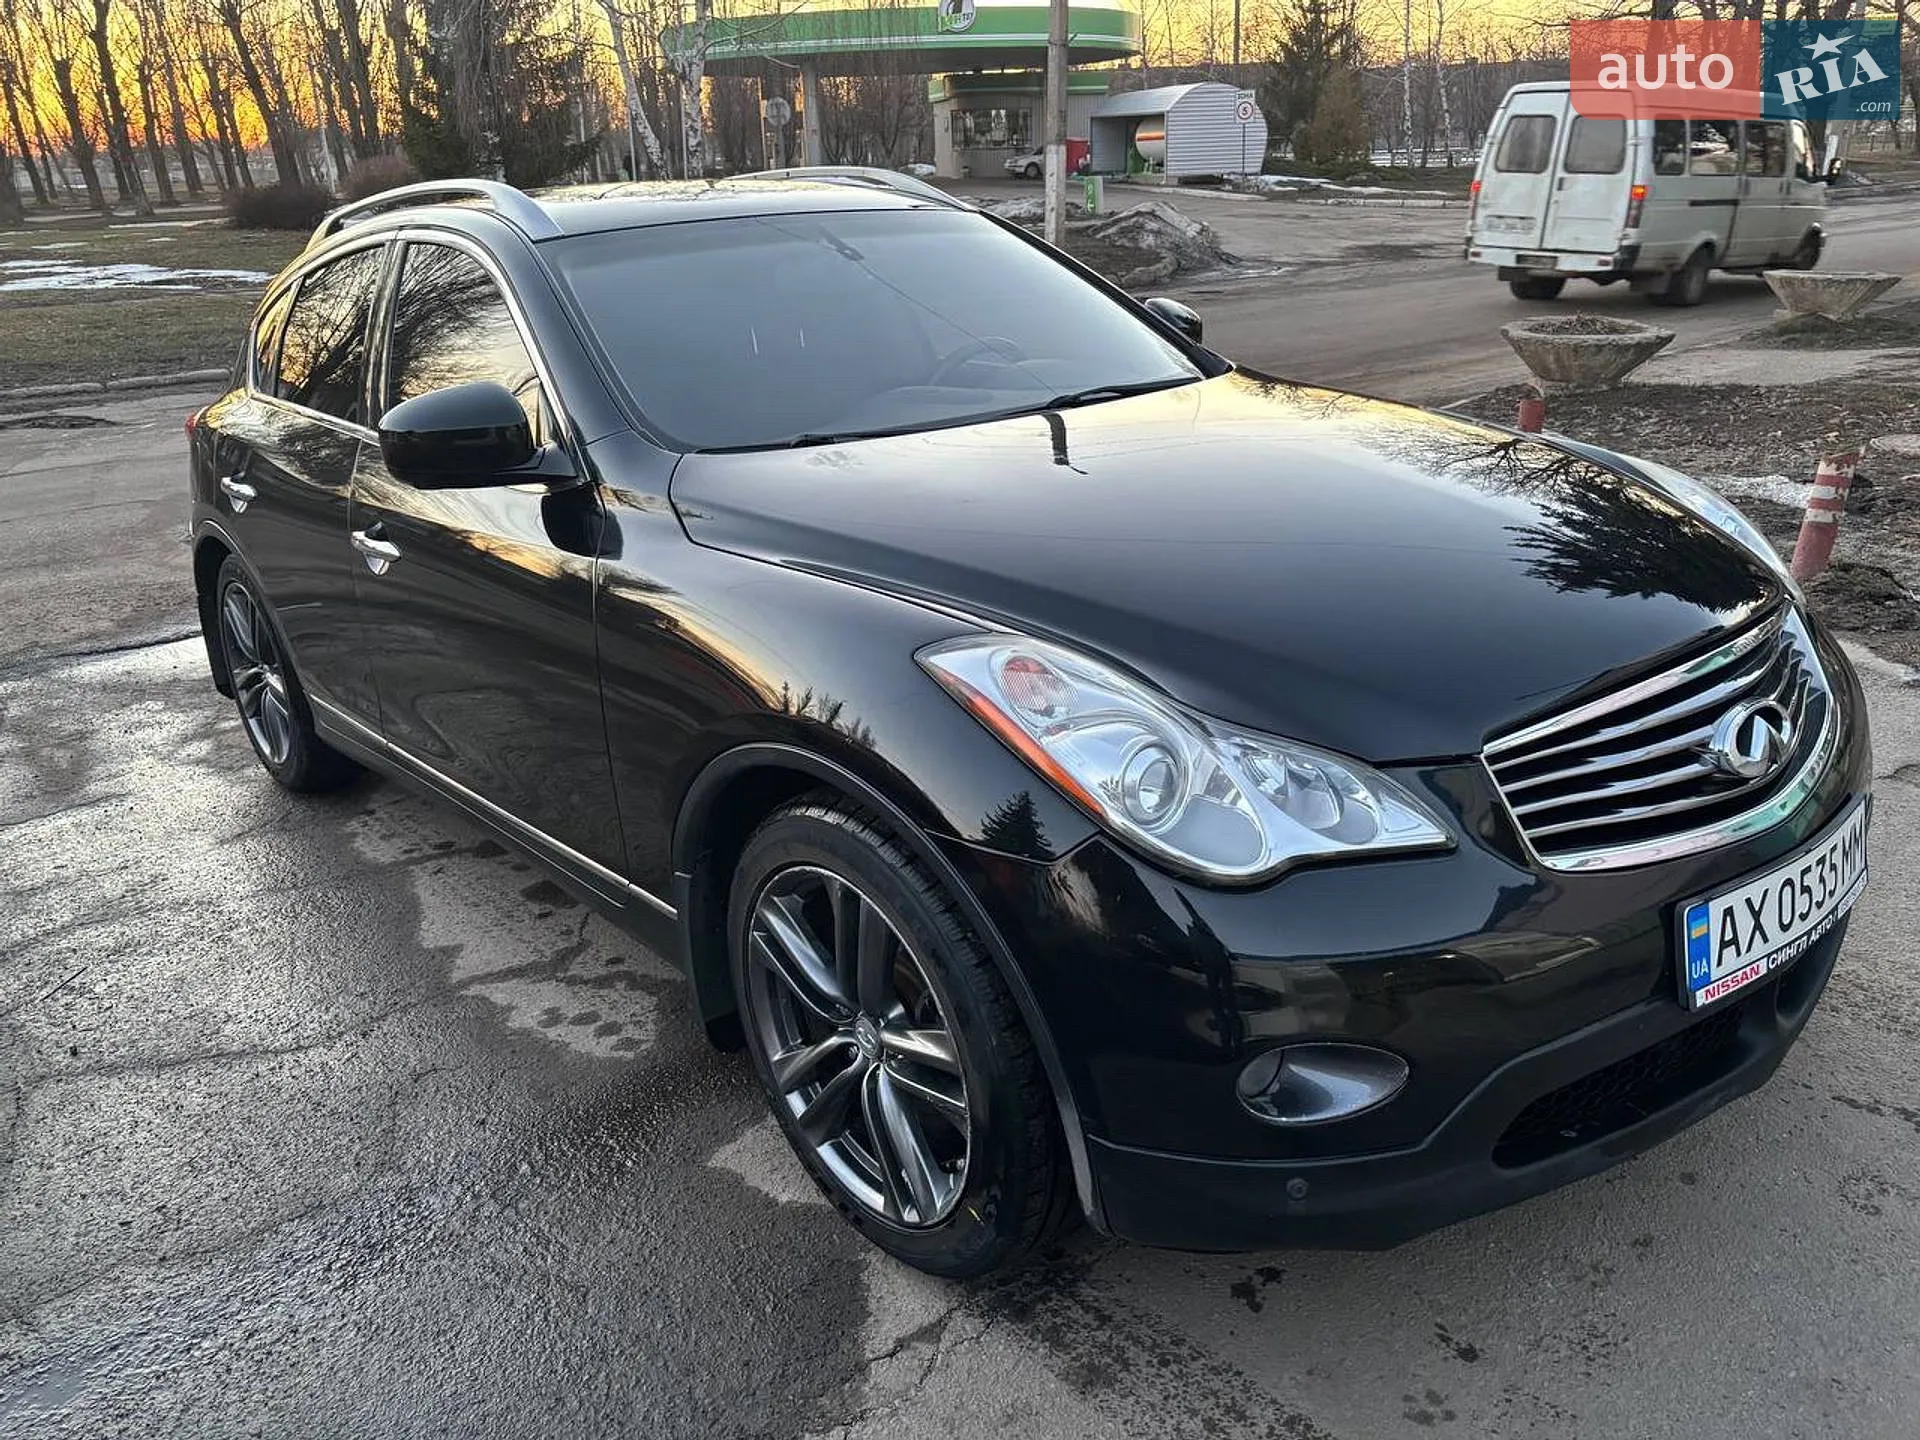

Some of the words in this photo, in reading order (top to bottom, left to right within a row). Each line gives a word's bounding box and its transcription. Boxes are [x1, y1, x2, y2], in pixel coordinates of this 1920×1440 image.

[1715, 887, 1770, 968] AX
[1778, 844, 1838, 934] 0535
[1691, 957, 1709, 979] UA
[1703, 963, 1760, 1002] NISSAN
